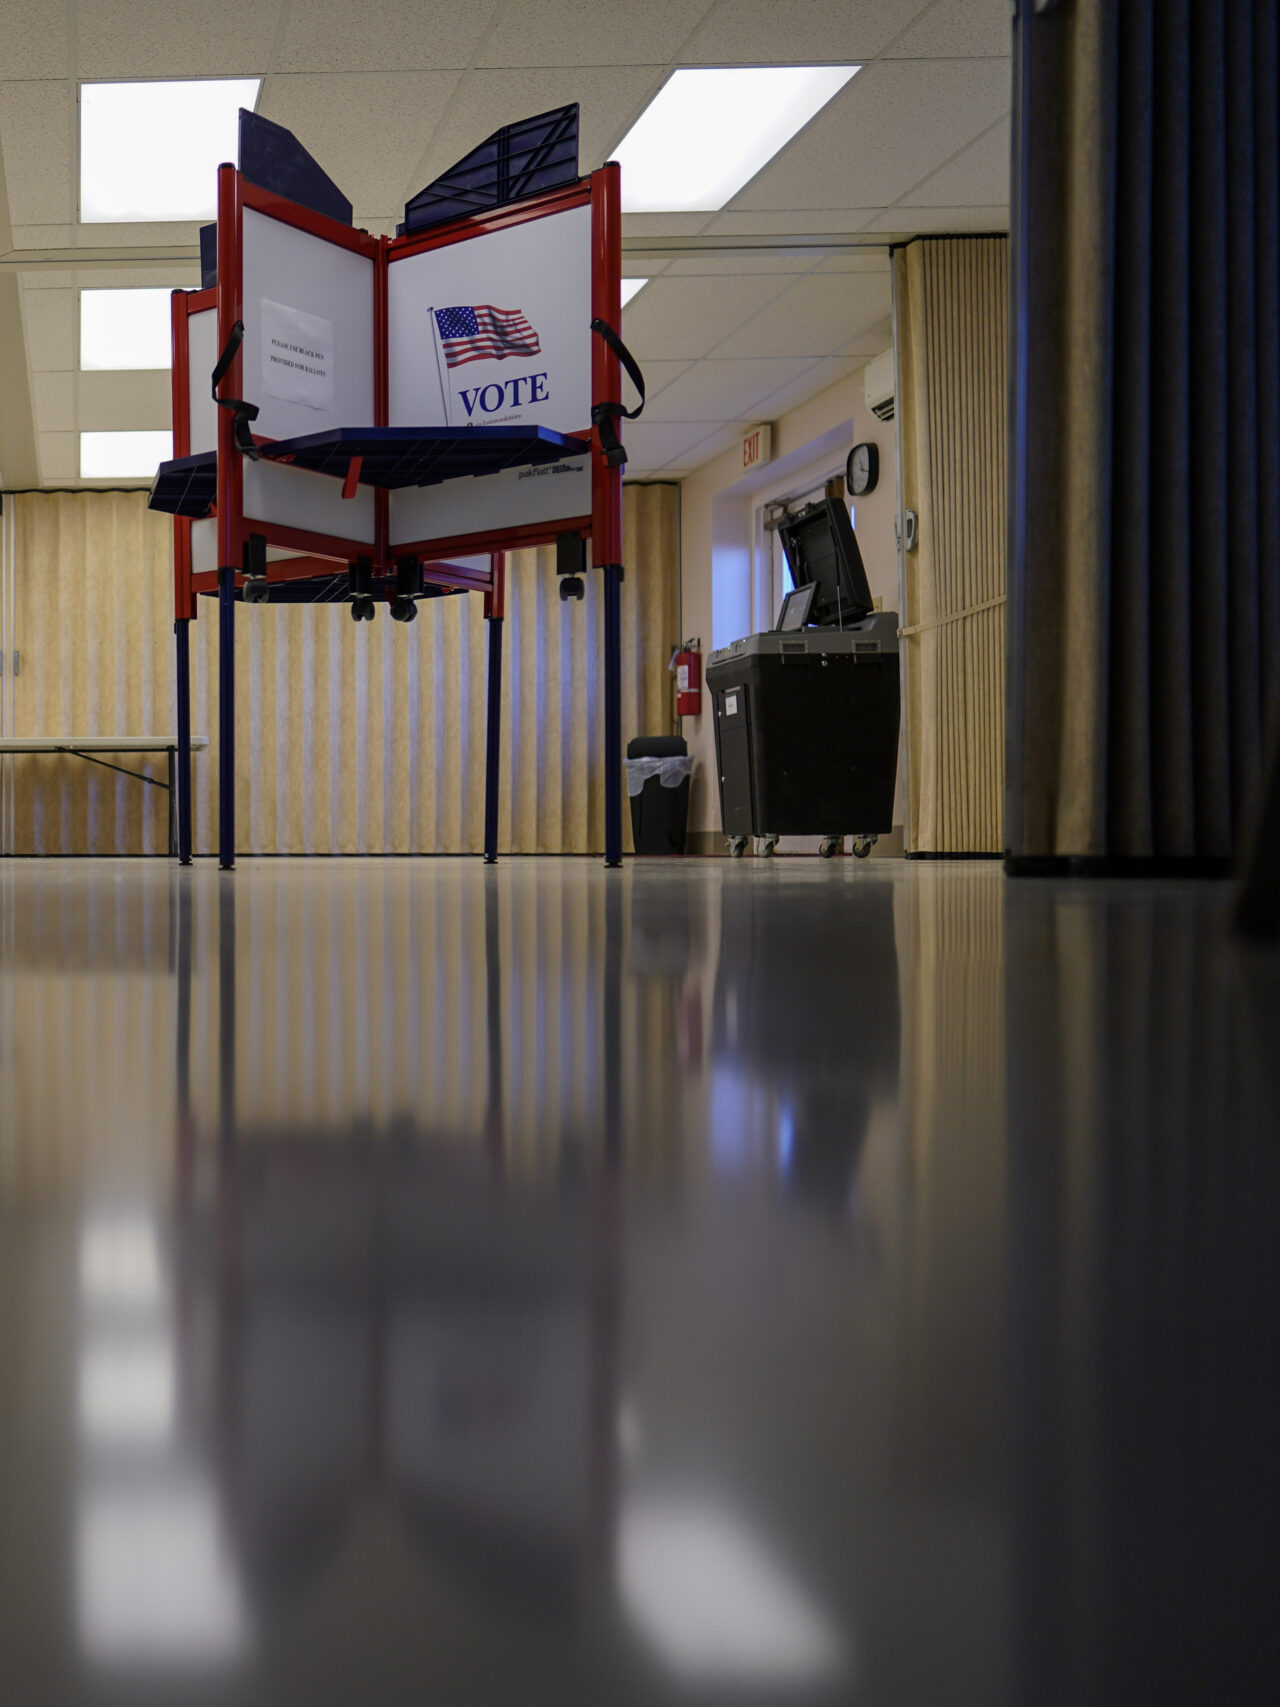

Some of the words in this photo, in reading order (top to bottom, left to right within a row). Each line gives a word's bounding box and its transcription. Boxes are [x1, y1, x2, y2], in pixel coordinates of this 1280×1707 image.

[271, 339, 289, 349] PLEASE
[299, 348, 314, 358] BLACK
[270, 355, 294, 367] PROVIDED
[295, 363, 304, 371] FOR
[305, 366, 326, 377] BALLOTS
[458, 373, 549, 417] VOTE
[744, 432, 760, 467] EXIT
